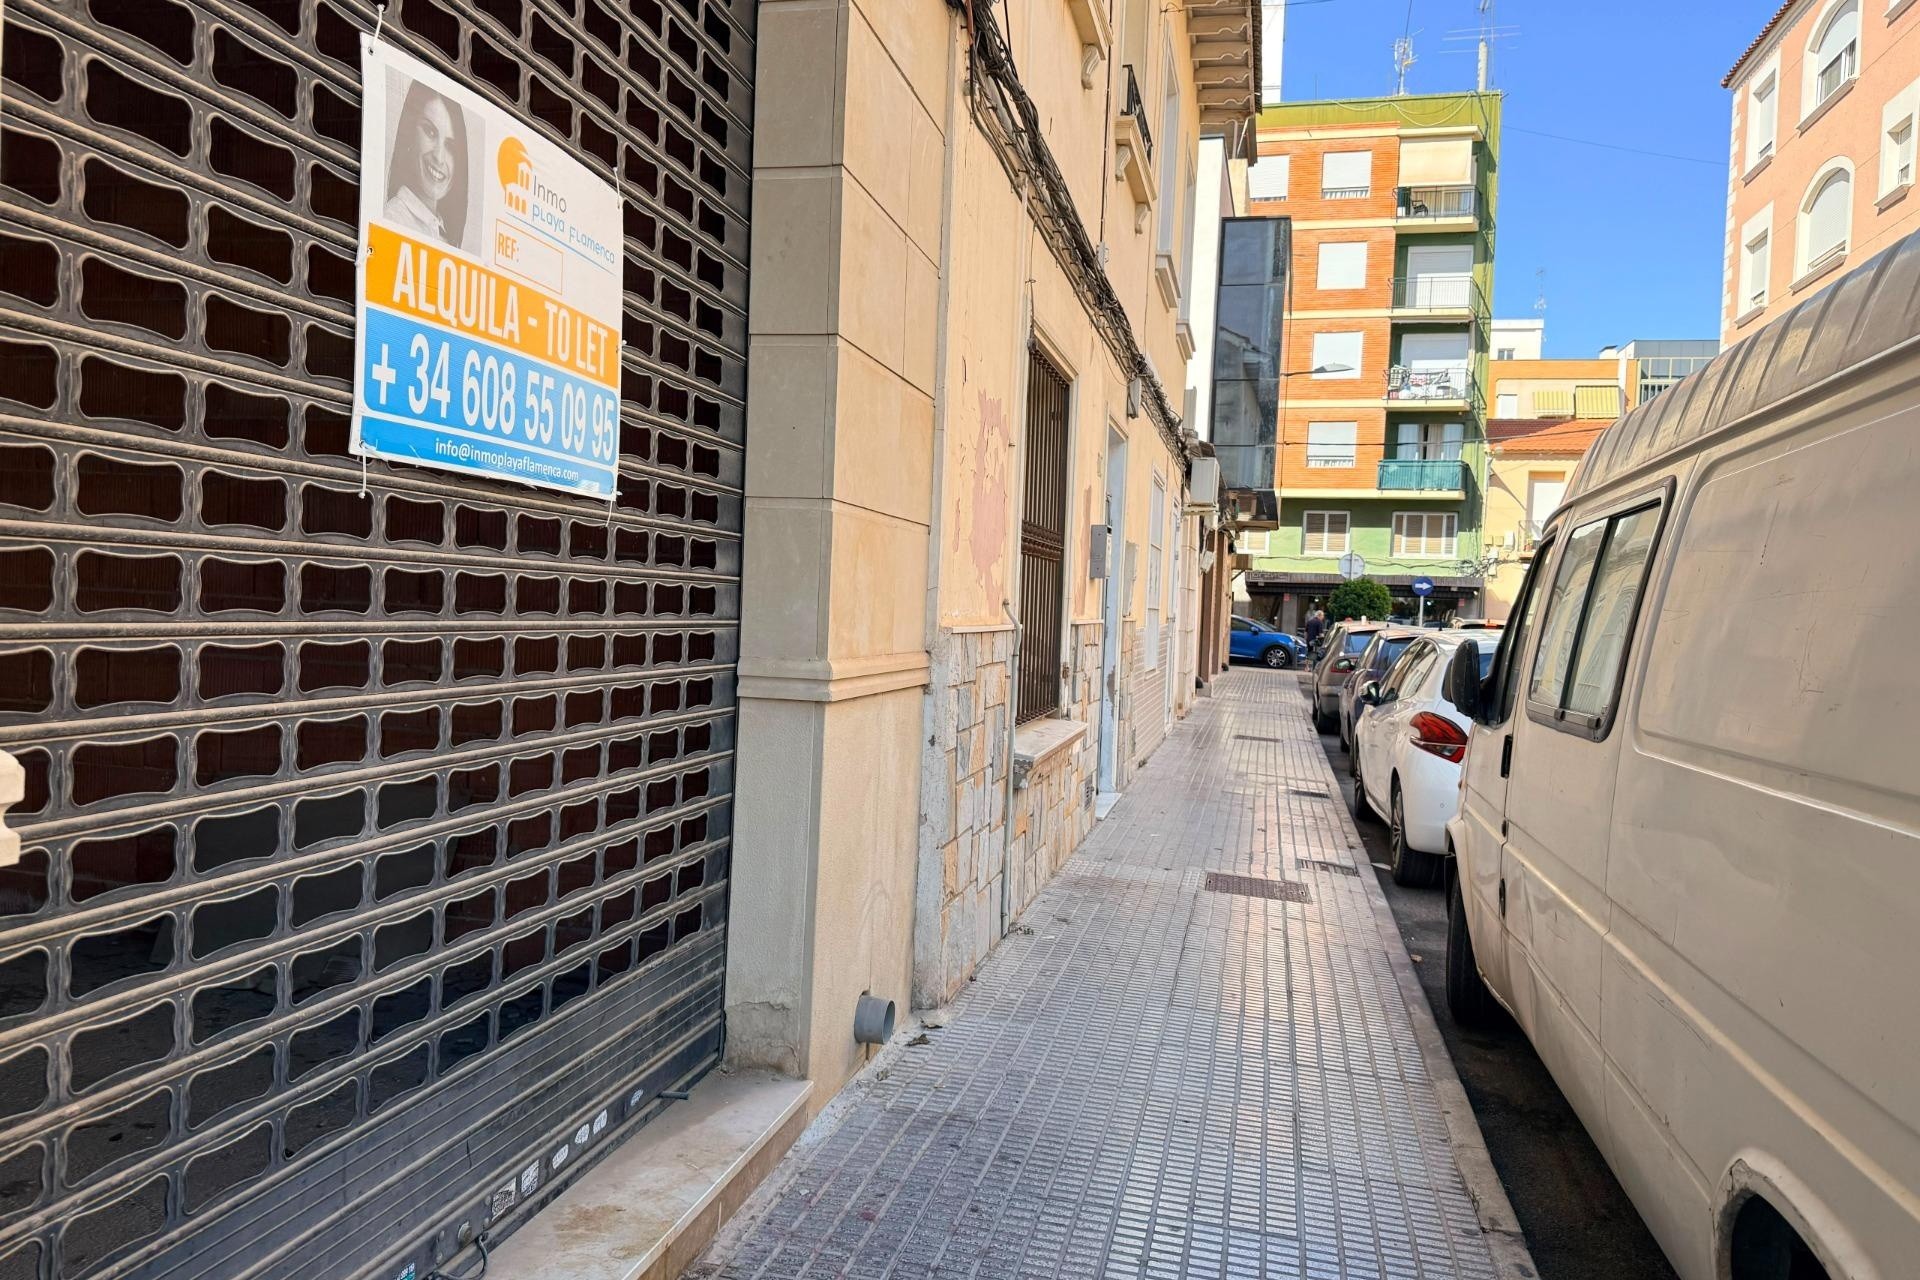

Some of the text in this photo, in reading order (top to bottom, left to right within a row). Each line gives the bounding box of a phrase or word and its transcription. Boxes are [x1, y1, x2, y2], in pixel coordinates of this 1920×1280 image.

[533, 175, 567, 213] Inmo
[497, 232, 520, 263] REF:
[393, 242, 521, 344] ALQUILA
[544, 300, 571, 362] TO
[575, 316, 609, 378] LET
[408, 333, 451, 419] 34
[462, 349, 516, 436] 608
[524, 369, 556, 444] 55
[561, 382, 586, 454] 09
[592, 393, 615, 462] 95
[435, 438, 579, 483] info@inmoplayaflamenca.com
